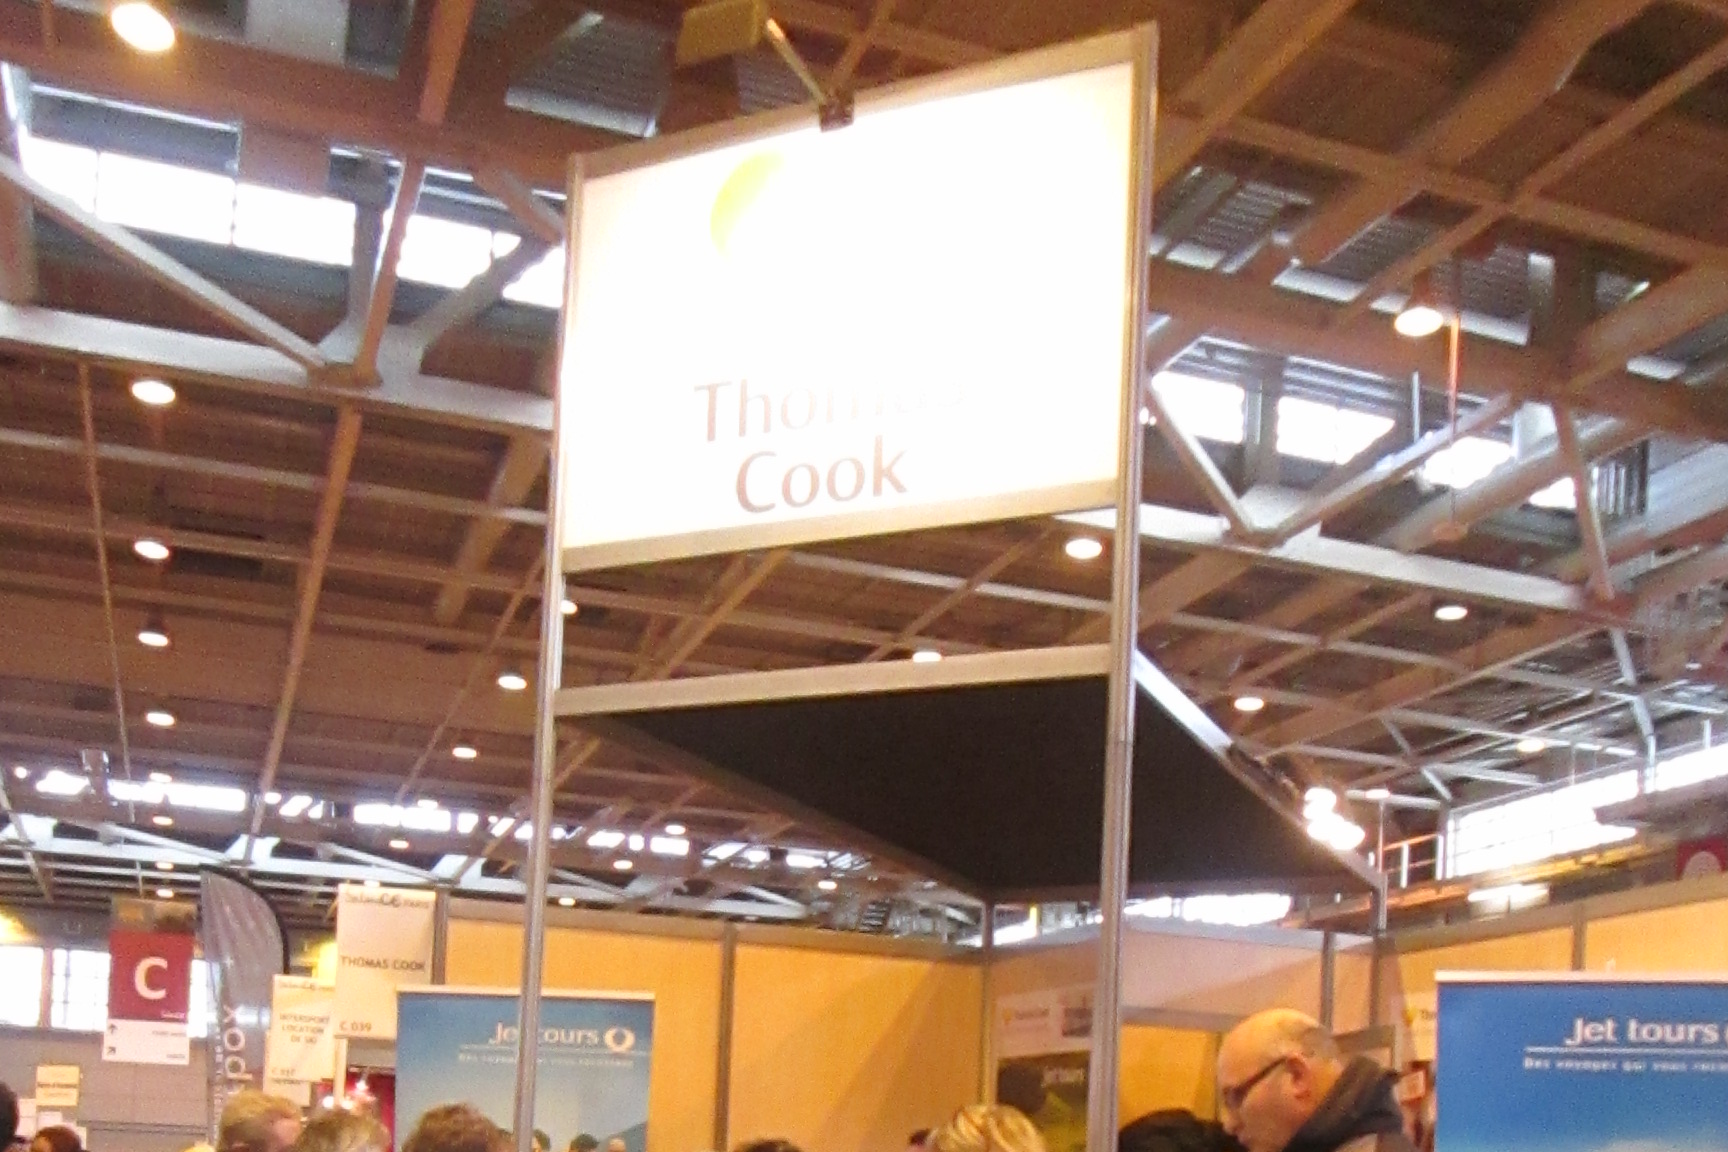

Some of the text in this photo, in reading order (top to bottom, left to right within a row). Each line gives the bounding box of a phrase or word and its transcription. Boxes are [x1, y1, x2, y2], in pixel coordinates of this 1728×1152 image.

[735, 434, 909, 515] Cook
[133, 956, 168, 1000] C
[340, 955, 389, 970] THOMAS
[1564, 1017, 1719, 1046] Jet tours
